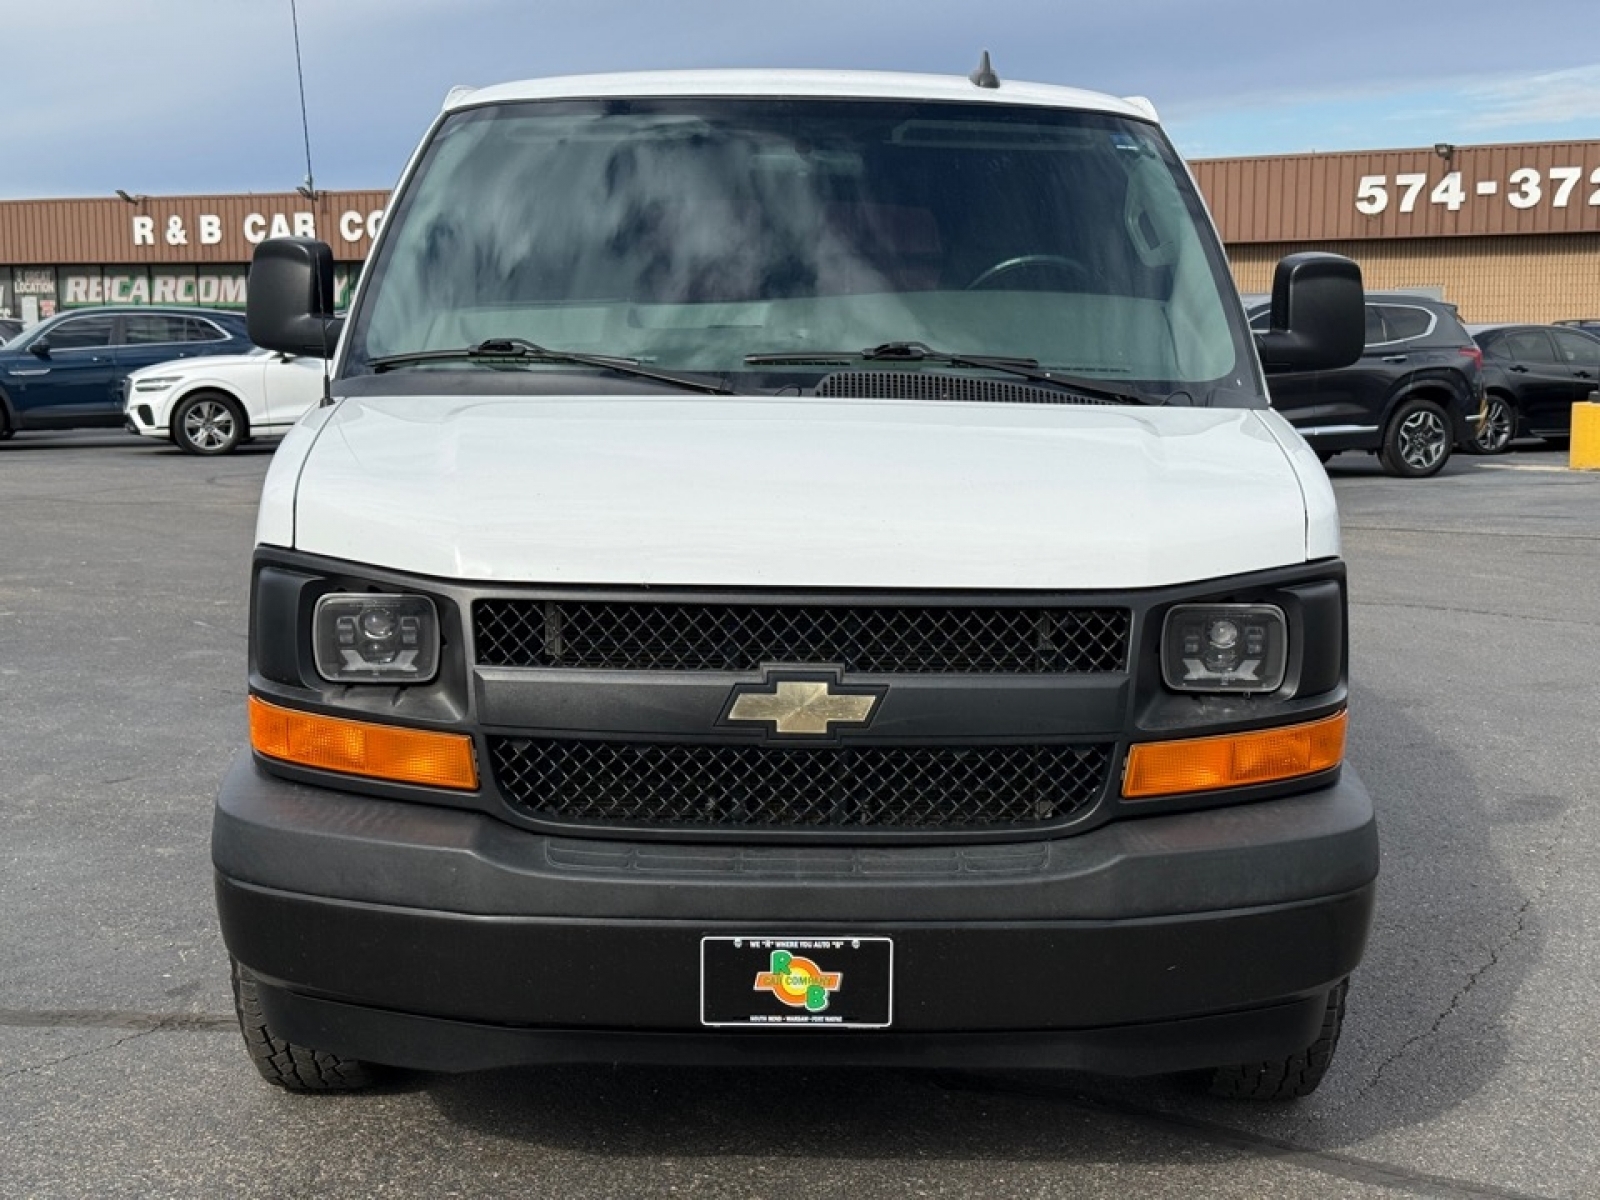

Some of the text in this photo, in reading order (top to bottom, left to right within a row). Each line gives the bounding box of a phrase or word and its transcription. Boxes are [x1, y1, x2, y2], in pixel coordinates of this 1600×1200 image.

[133, 215, 155, 246] R
[165, 213, 188, 245] &
[200, 214, 222, 244] B
[244, 211, 316, 244] CAR
[771, 950, 792, 975] R
[805, 985, 828, 1010] B
